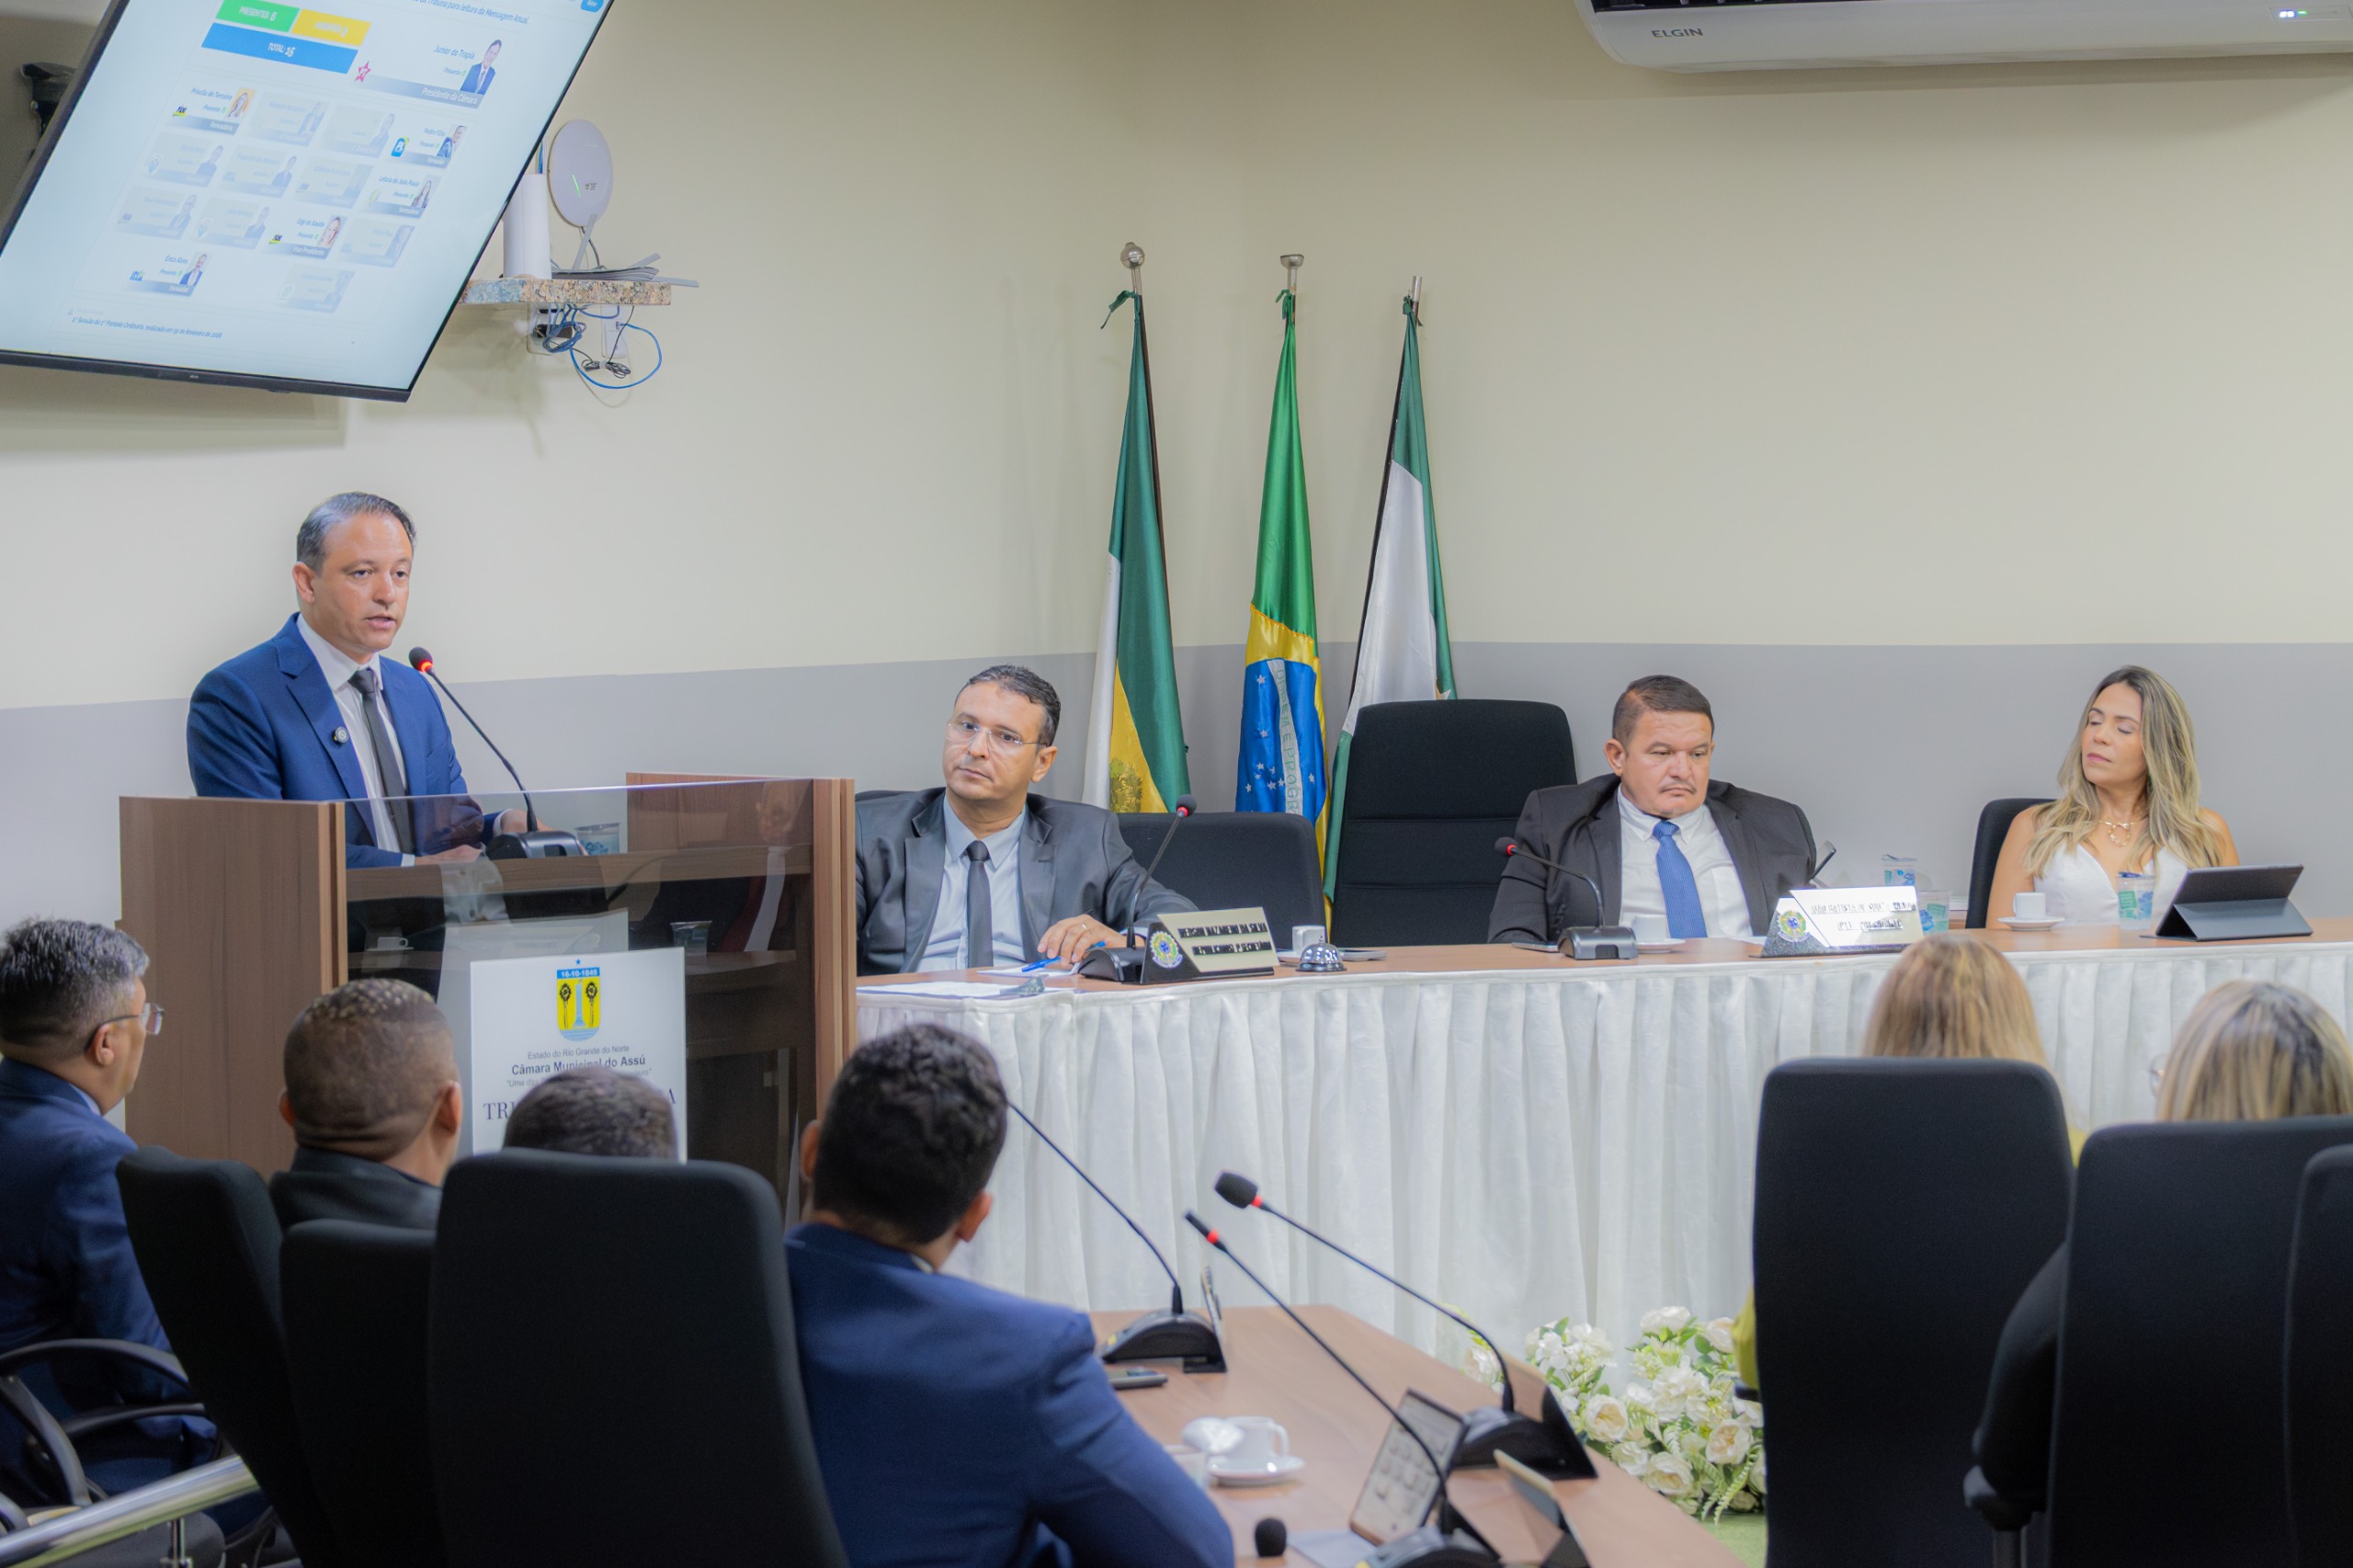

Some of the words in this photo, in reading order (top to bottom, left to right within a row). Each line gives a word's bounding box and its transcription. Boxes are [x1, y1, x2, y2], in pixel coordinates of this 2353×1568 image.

[485, 8, 513, 21] Mensagem
[512, 15, 529, 24] Anual
[1651, 28, 1703, 38] ELGIN
[422, 87, 449, 99] Presidente
[562, 969, 598, 978] 16-10-1845
[528, 1051, 551, 1060] Estado
[563, 1048, 574, 1057] Rio
[575, 1047, 600, 1056] Grande
[611, 1044, 630, 1053] Norte
[512, 1062, 551, 1075] Câmara
[605, 1057, 617, 1068] do
[620, 1054, 645, 1066] Assú
